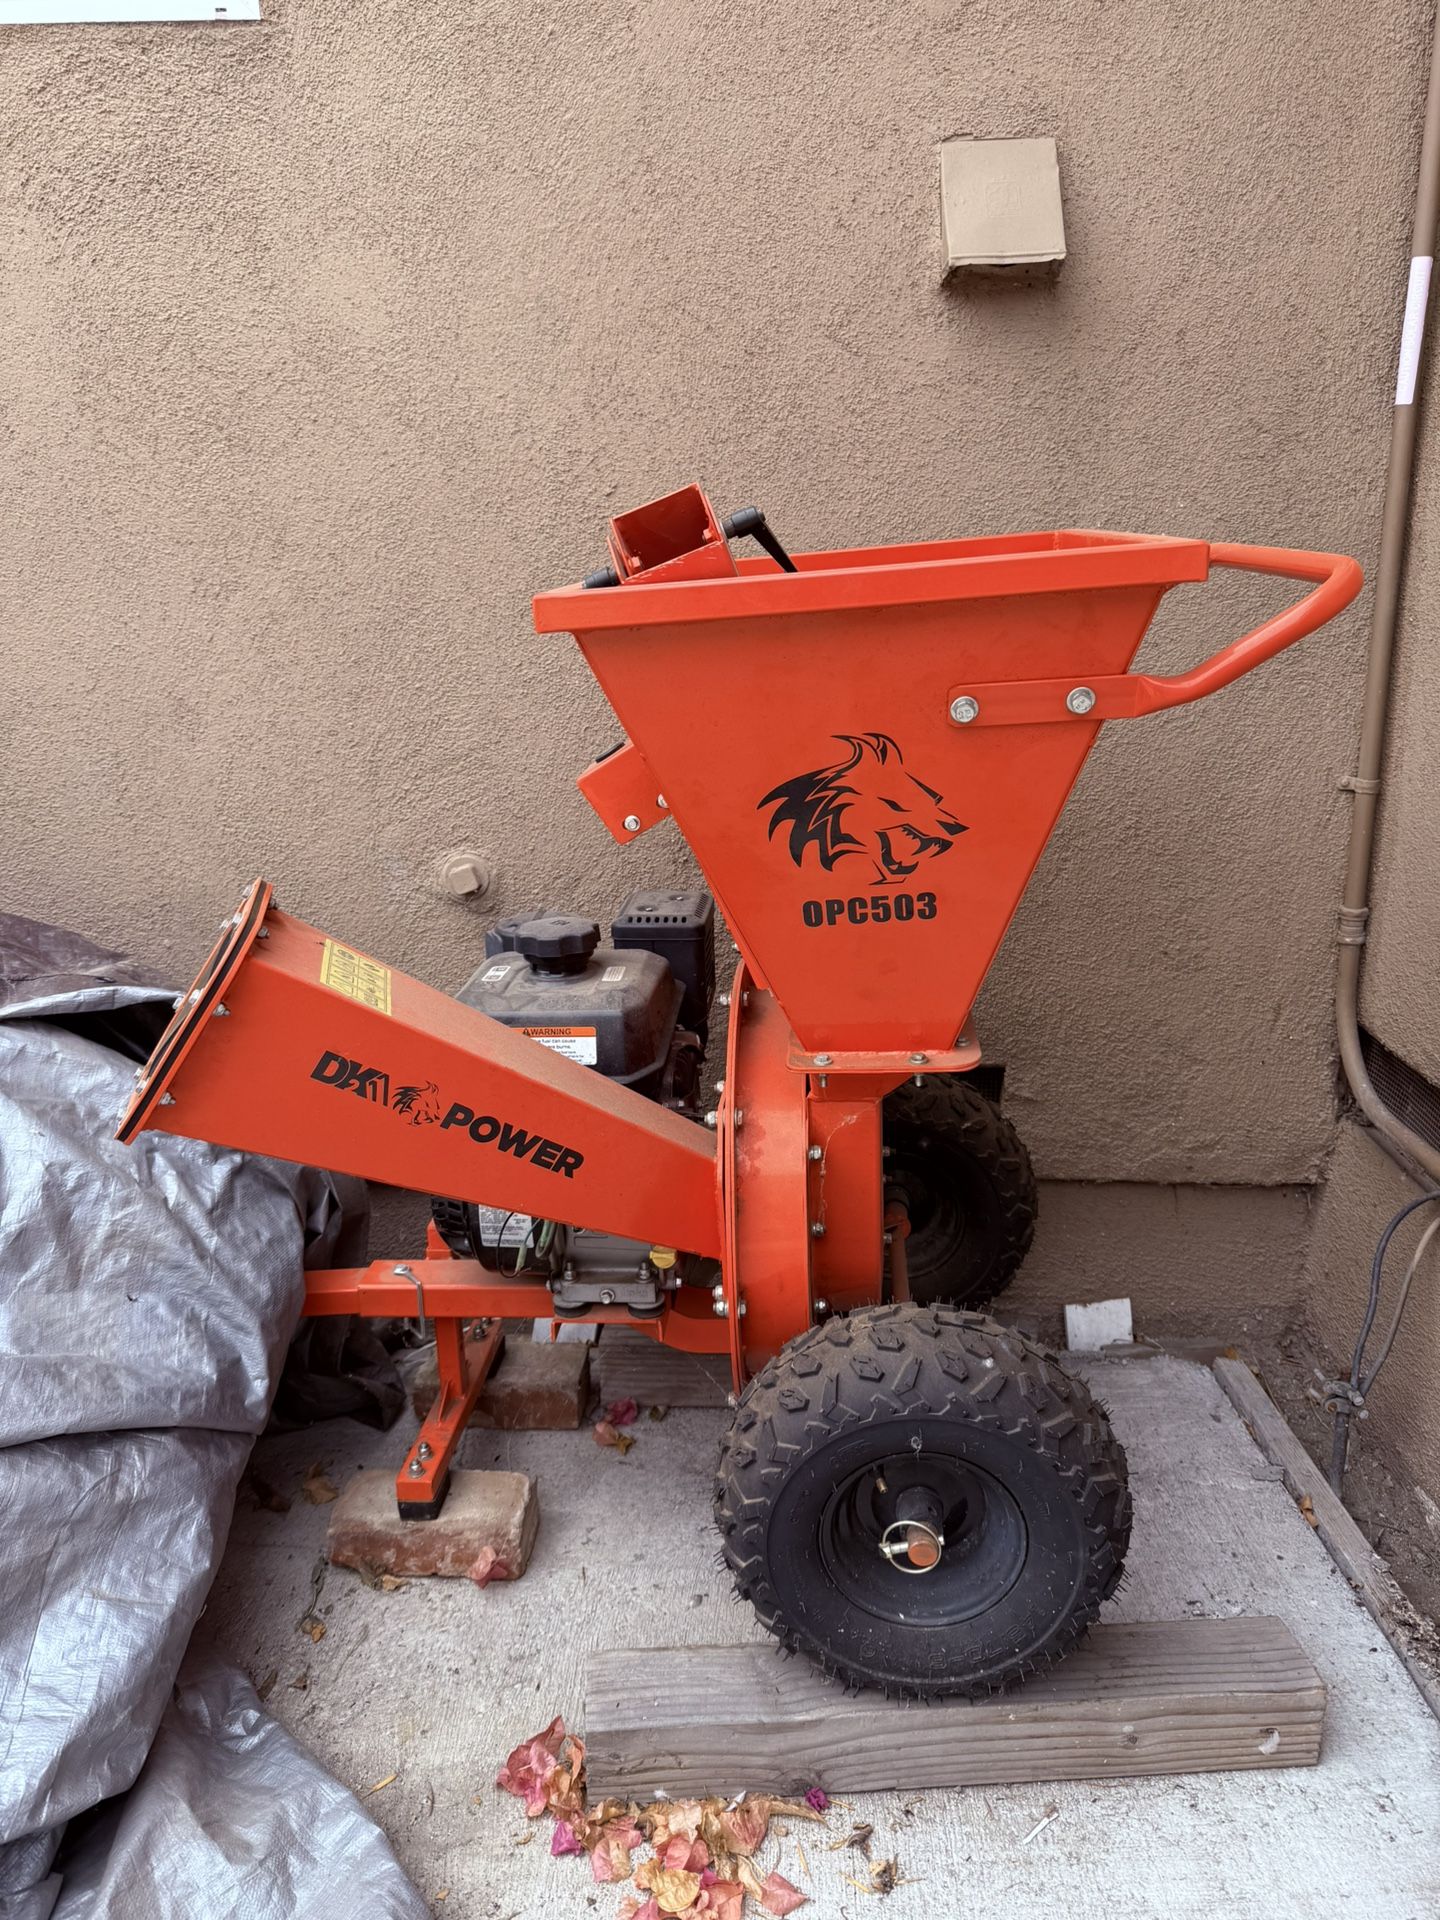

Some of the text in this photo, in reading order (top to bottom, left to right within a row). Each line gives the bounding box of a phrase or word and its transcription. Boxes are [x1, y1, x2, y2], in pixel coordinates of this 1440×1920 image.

[802, 891, 938, 928] OPC503
[530, 1028, 571, 1036] WARNING
[440, 1102, 585, 1179] POWER
